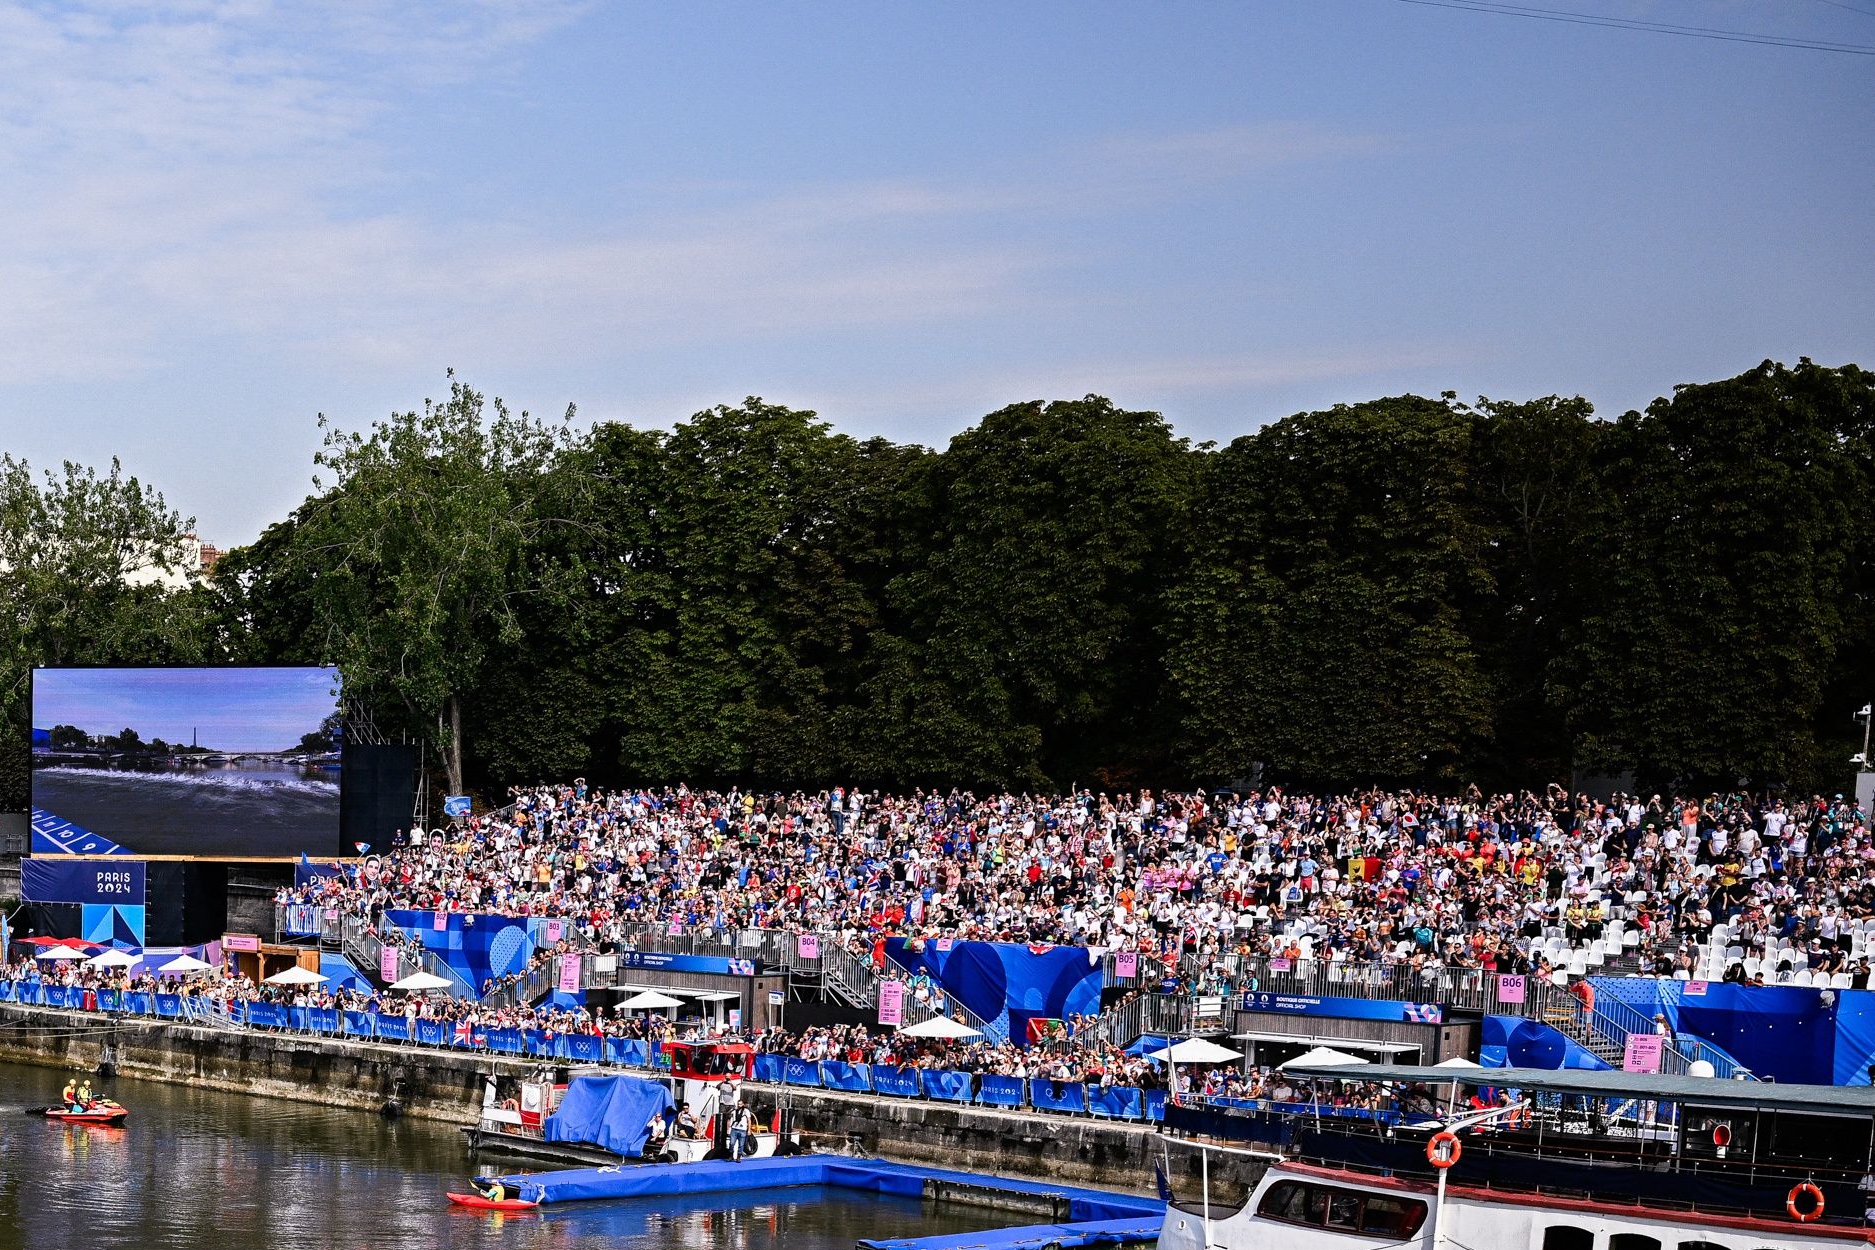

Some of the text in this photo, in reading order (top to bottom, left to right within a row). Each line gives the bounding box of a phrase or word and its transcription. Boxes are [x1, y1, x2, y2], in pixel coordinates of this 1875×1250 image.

[97, 883, 130, 894] 2024
[436, 911, 446, 920] B02
[549, 922, 559, 930] B03
[802, 937, 815, 946] B04
[1118, 954, 1134, 964] B05
[1502, 977, 1522, 988] B06
